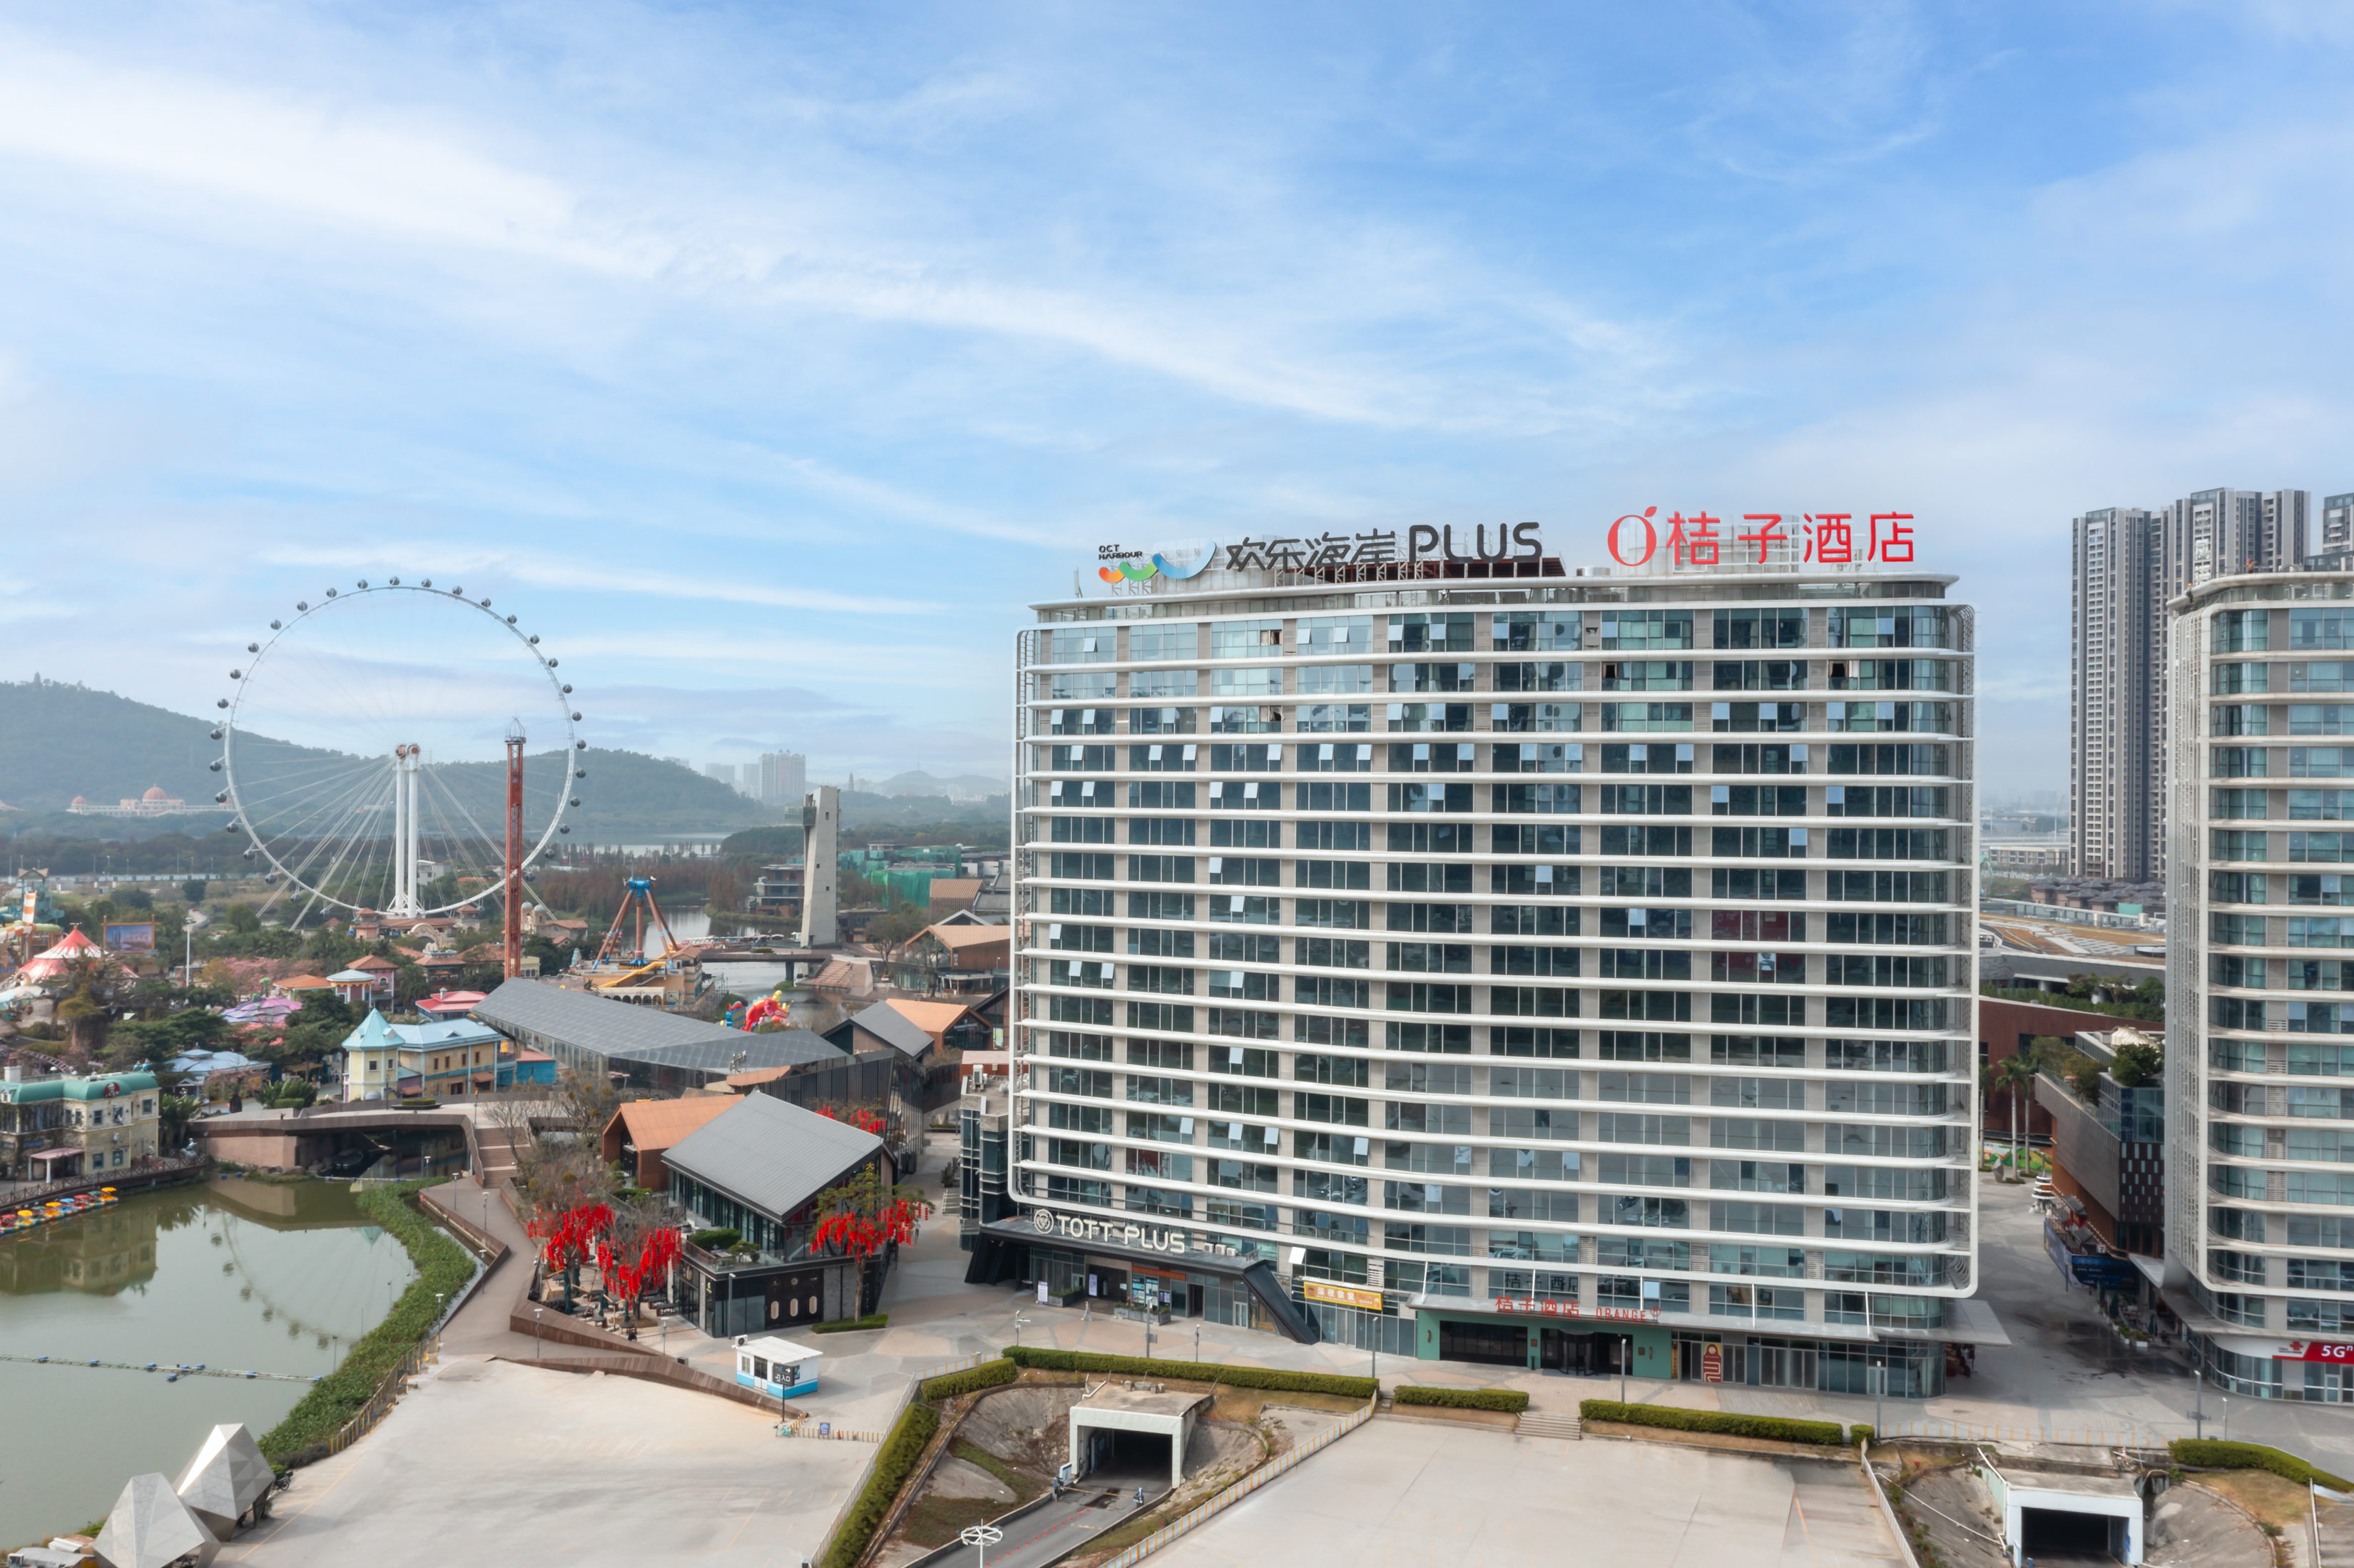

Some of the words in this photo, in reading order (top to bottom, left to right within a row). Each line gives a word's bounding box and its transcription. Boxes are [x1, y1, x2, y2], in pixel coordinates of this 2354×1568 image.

[1226, 528, 1395, 572] 欢乐海岸
[1409, 522, 1543, 564] PLUS
[1666, 511, 1913, 565] 桔子酒店
[1099, 544, 1120, 553] OCT
[1099, 551, 1143, 560] HARBOUR
[1056, 1215, 1114, 1242] TOTT
[1124, 1226, 1186, 1253] PLUS
[1495, 1295, 1580, 1317] 桔子酒店
[1596, 1307, 1646, 1322] ORANGE
[781, 1374, 790, 1383] 入口
